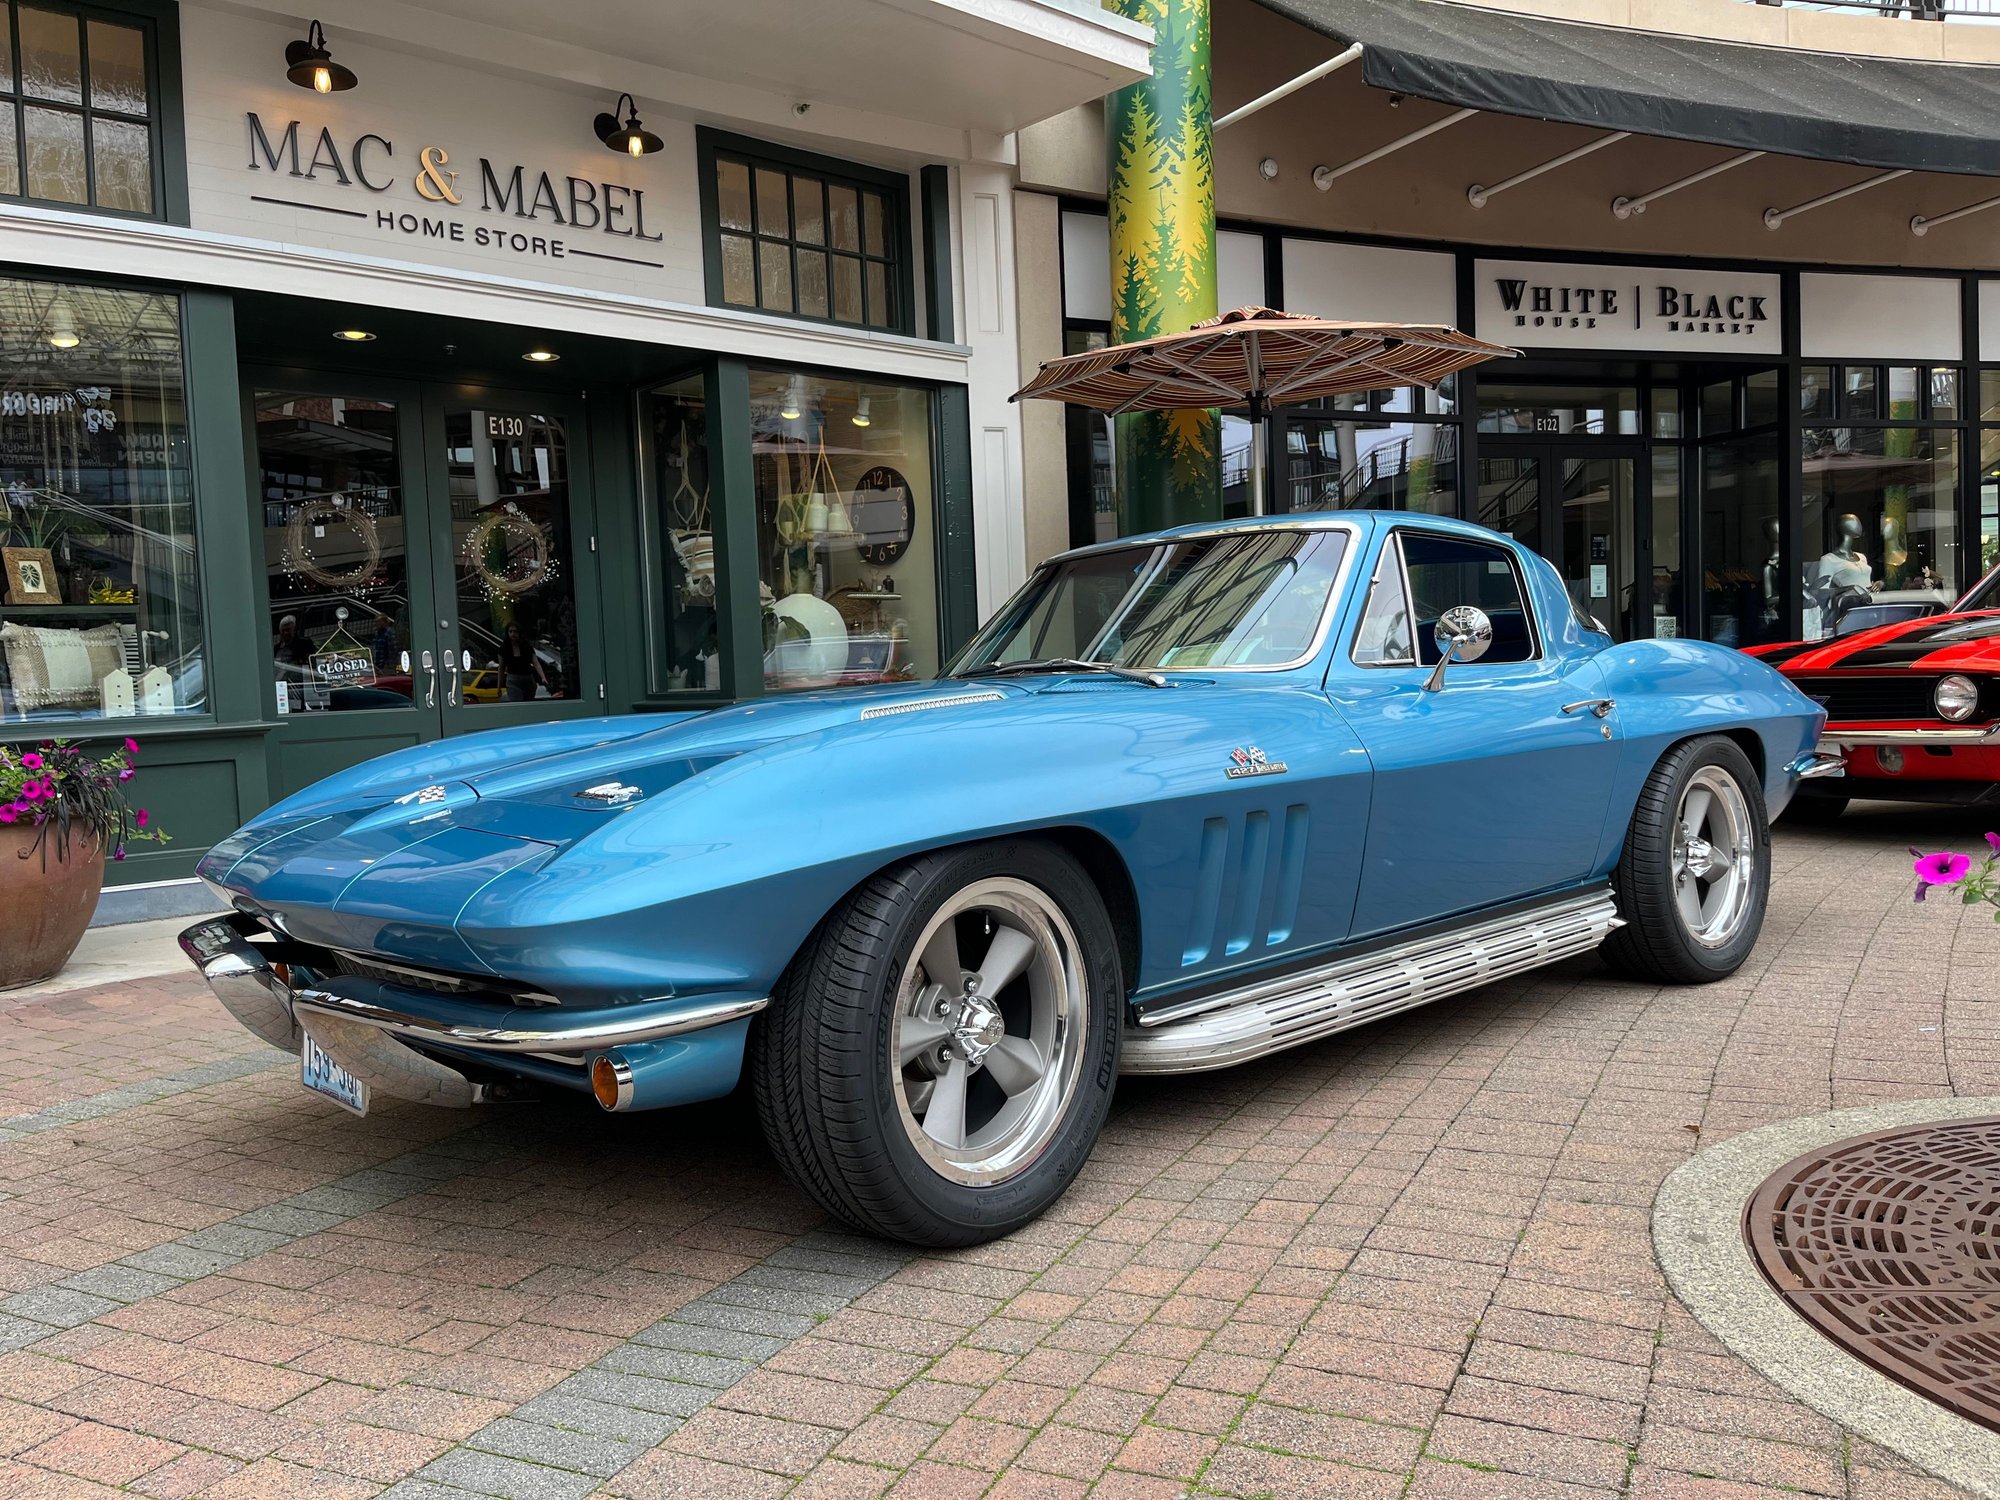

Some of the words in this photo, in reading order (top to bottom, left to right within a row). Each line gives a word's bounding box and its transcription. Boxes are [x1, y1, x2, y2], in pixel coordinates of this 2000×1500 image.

[247, 112, 394, 192] MAC
[414, 146, 464, 204] &
[479, 158, 663, 241] MABEL
[377, 210, 465, 242] HOME
[475, 227, 565, 258] STORE
[1494, 279, 1618, 315] WHITE
[1656, 286, 1768, 321] BLACK
[1515, 315, 1597, 329] HOUSE
[1668, 321, 1755, 334] MARKET
[489, 416, 523, 437] E130
[1537, 418, 1558, 431] E122
[873, 471, 883, 485] 12
[887, 475, 892, 489] 1
[896, 487, 903, 501] 2
[902, 506, 908, 520] 3
[879, 547, 886, 561] 6
[317, 658, 368, 675] CLOSED
[1232, 766, 1254, 775] 427
[877, 957, 900, 1076] MICHELIN
[1100, 992, 1117, 1090] MICHELIN
